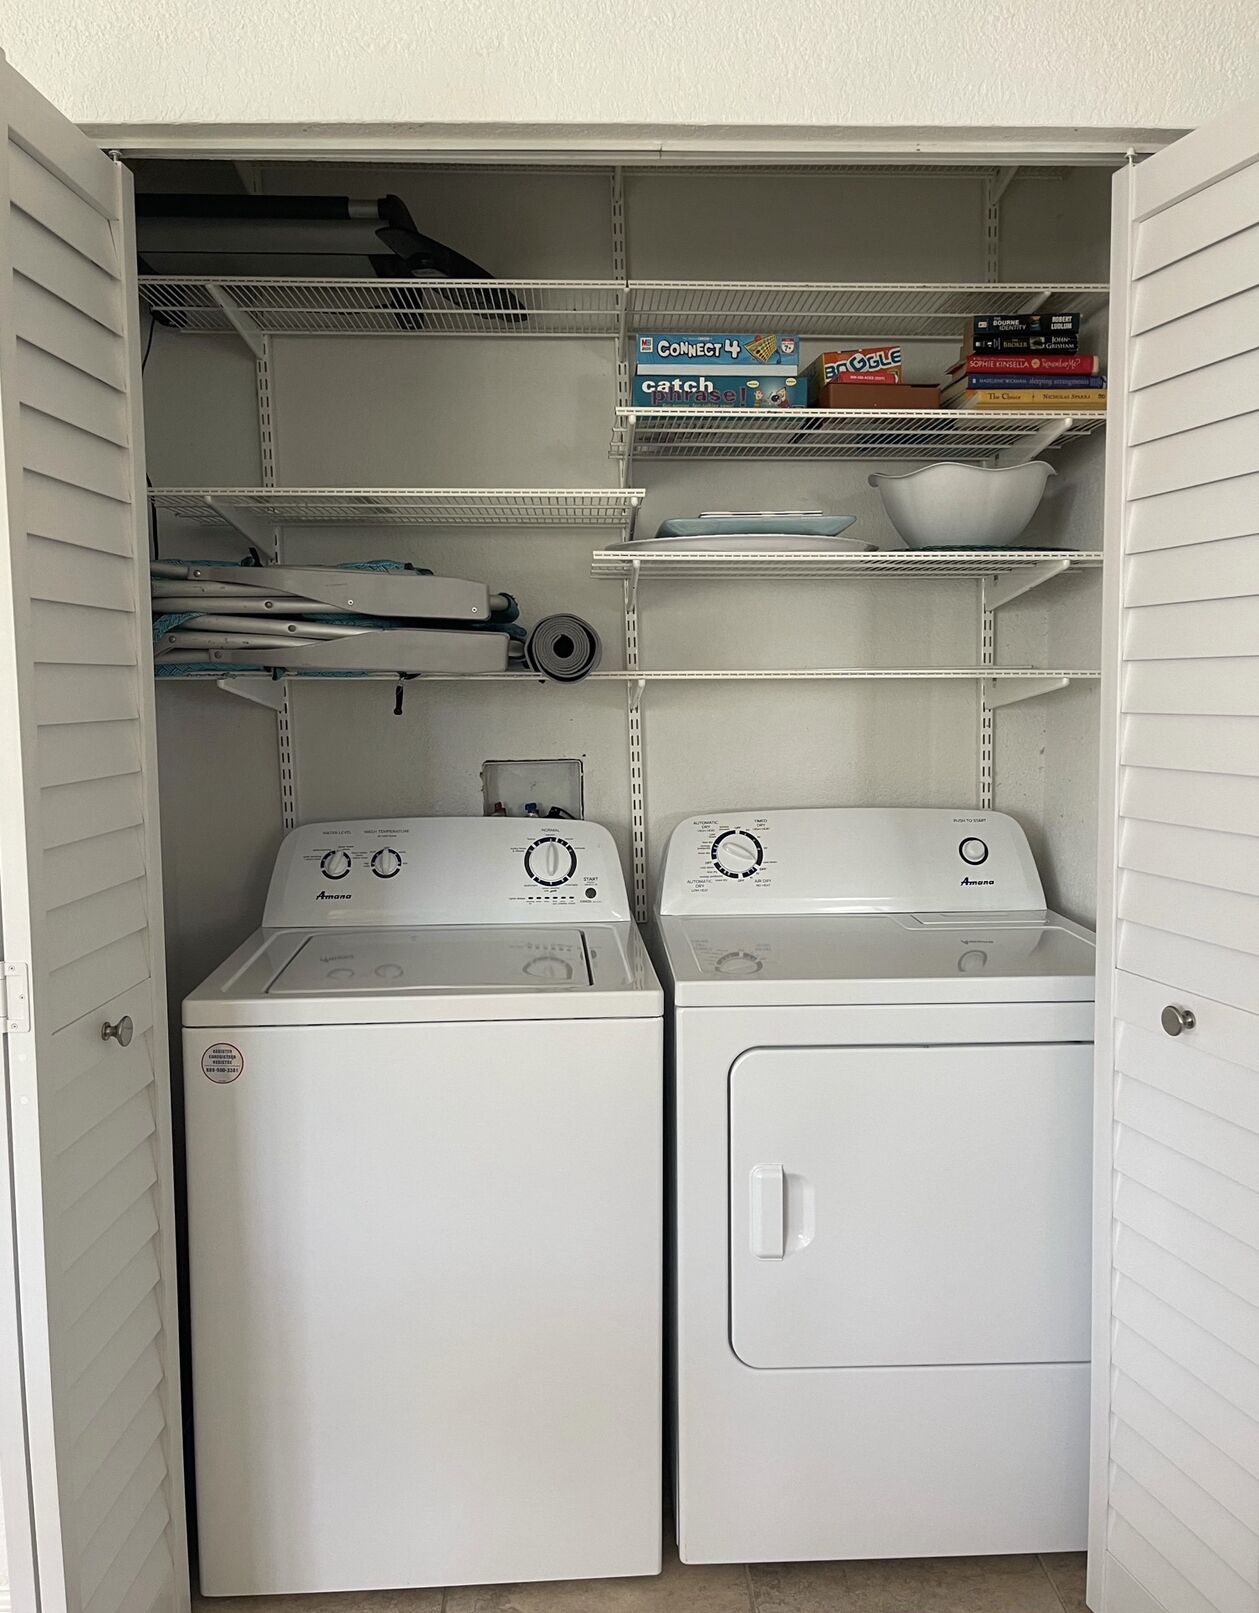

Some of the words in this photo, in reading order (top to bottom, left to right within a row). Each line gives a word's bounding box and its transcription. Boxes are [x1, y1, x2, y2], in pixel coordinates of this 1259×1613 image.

[1050, 322, 1073, 330] LUDLUM
[657, 339, 723, 358] CONNECT
[724, 338, 741, 359] 4
[969, 360, 994, 368] SOPHIE
[995, 360, 1030, 369] KINSELLA
[641, 376, 714, 394] catch
[651, 386, 747, 407] phrase!
[987, 392, 1000, 400] The
[960, 876, 995, 887] Amana
[315, 890, 352, 901] Amana
